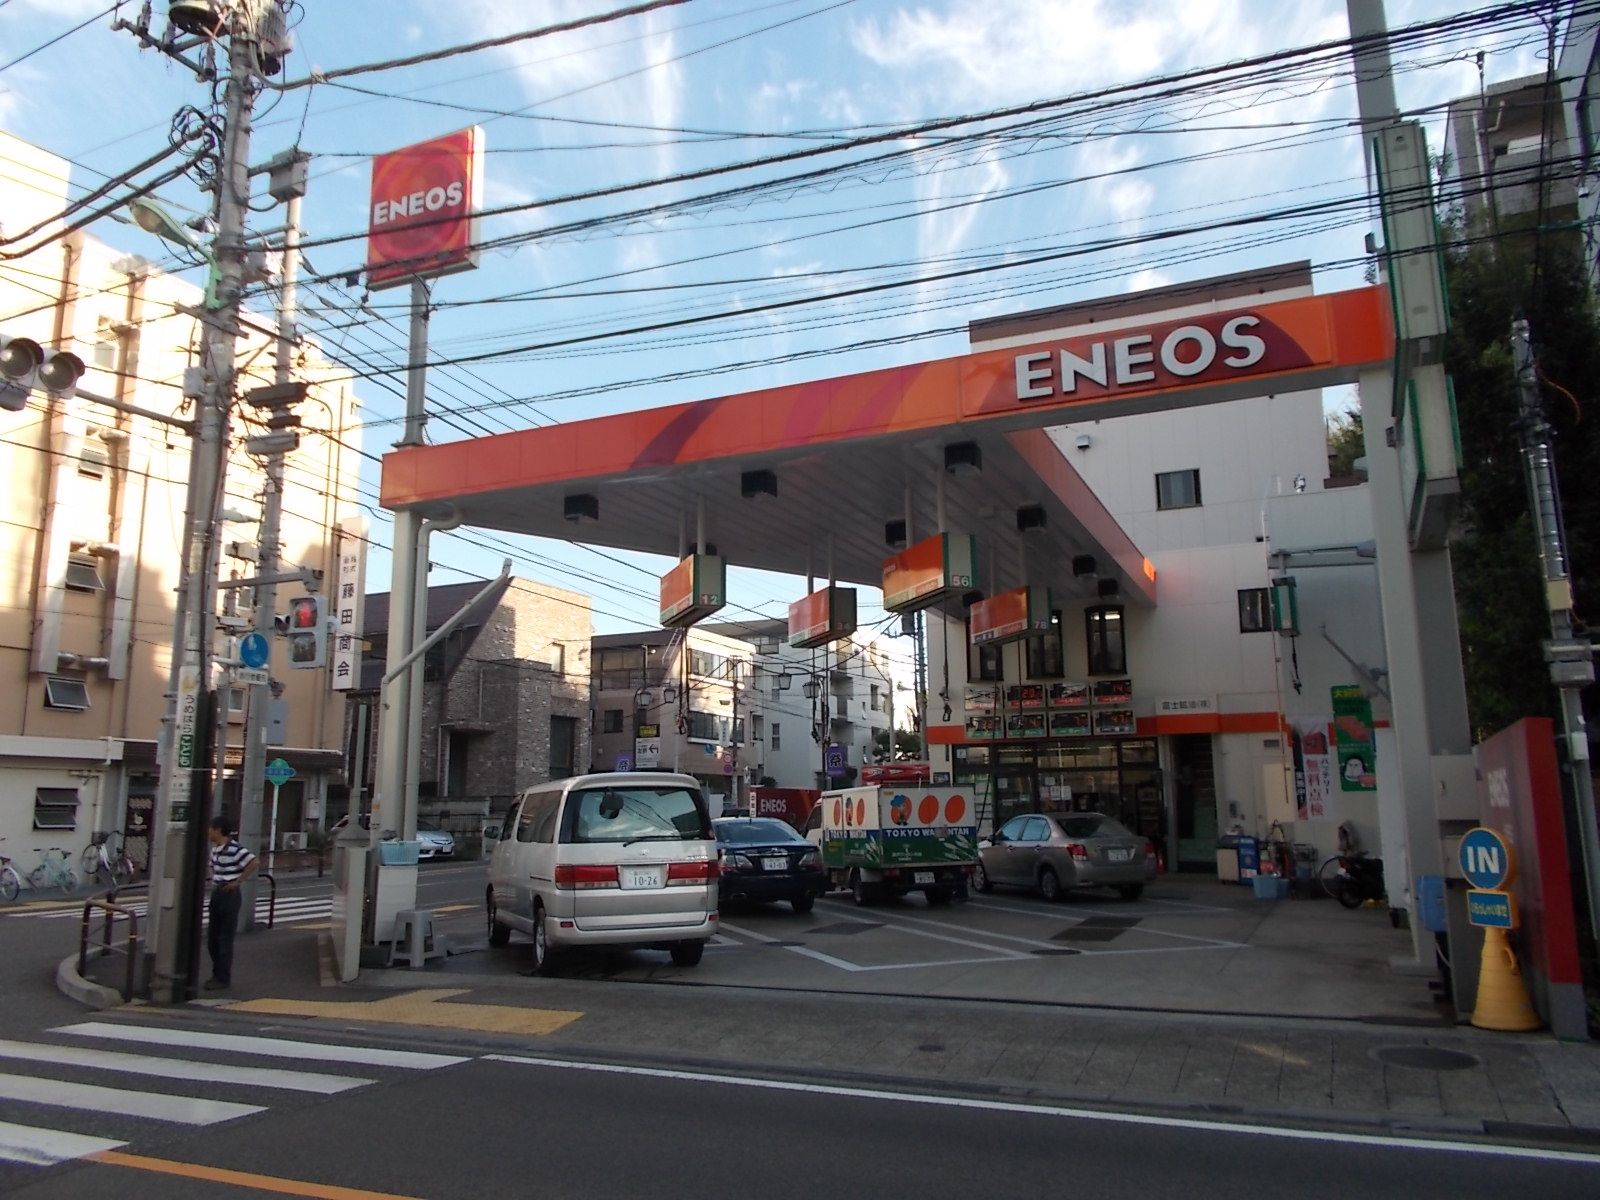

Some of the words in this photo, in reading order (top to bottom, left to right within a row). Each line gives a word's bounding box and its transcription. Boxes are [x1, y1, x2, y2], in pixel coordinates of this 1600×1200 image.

[373, 181, 463, 226] ENEOS
[1014, 315, 1267, 400] ENEOS
[952, 575, 969, 587] 56
[338, 583, 355, 677] 藤田商会
[760, 798, 788, 813] ENEOS
[886, 828, 921, 838] TOKYO
[1467, 846, 1500, 874] IN
[633, 876, 658, 886] 10-26
